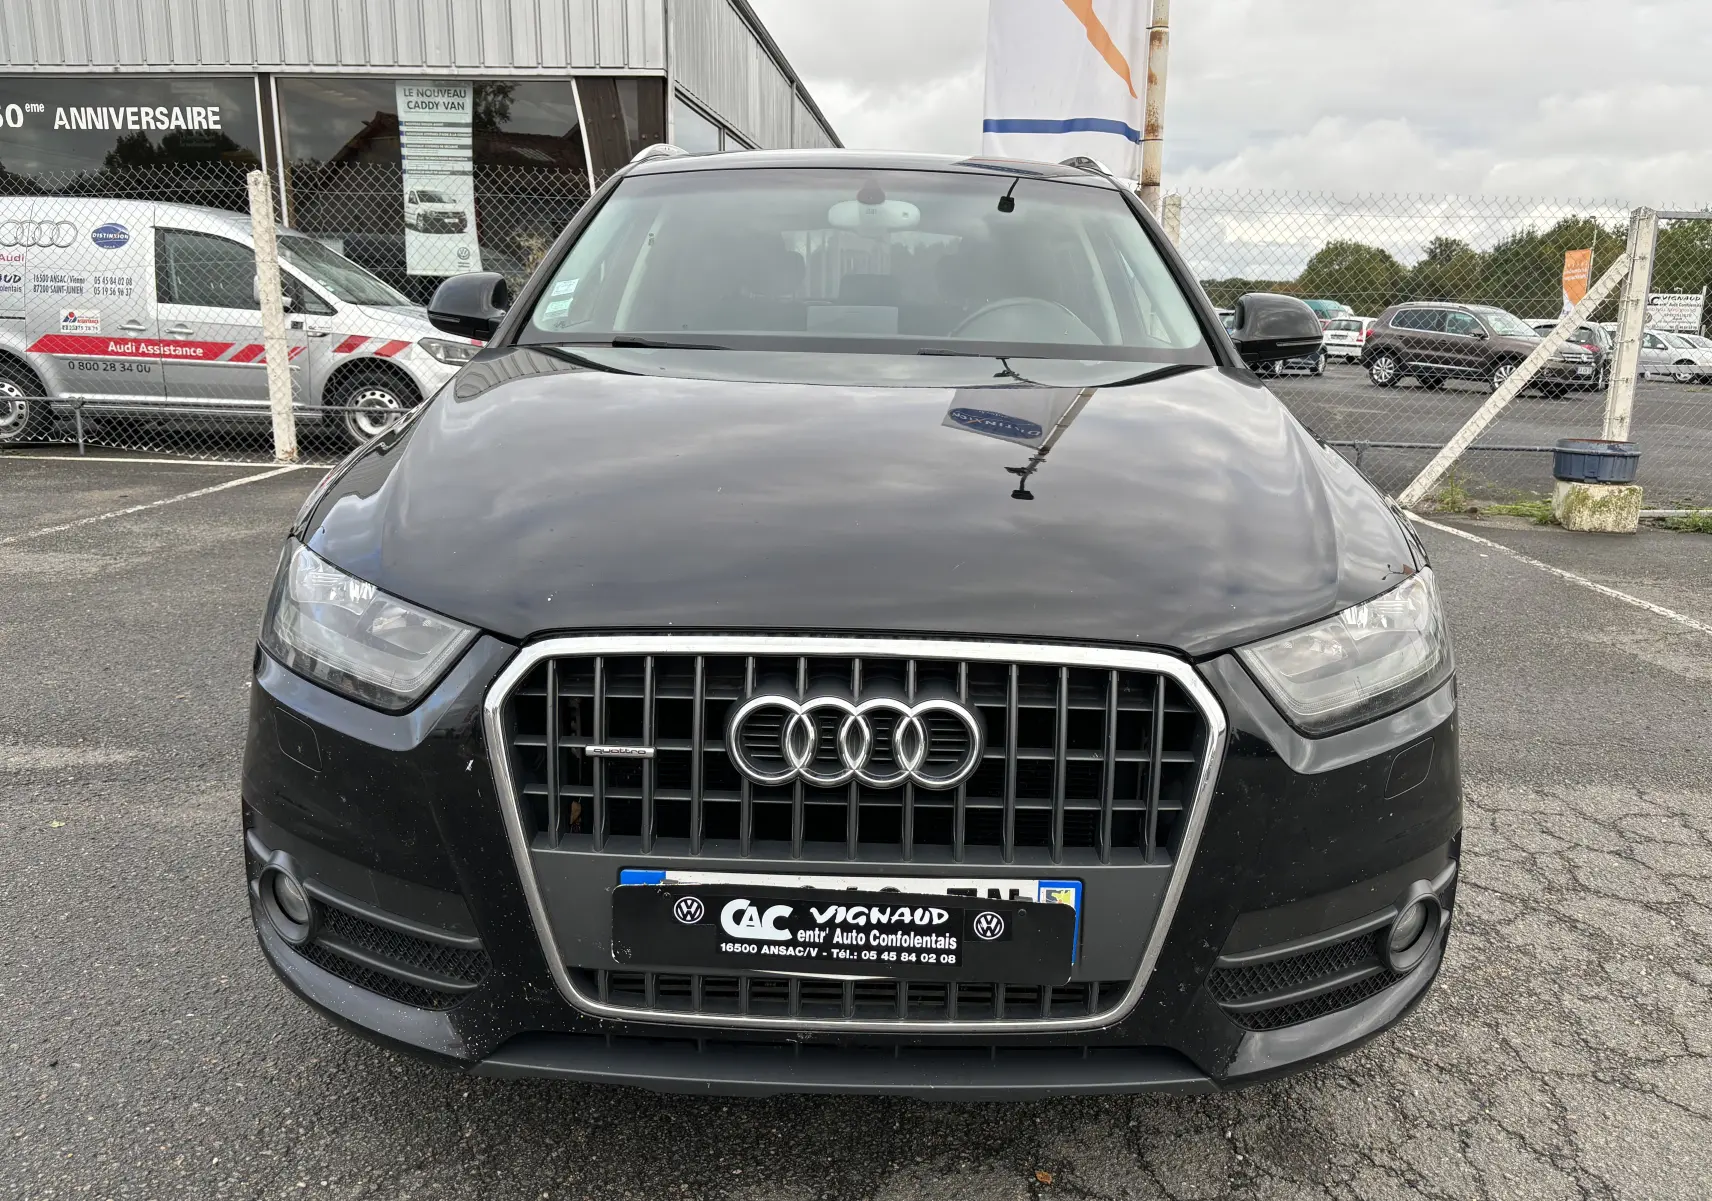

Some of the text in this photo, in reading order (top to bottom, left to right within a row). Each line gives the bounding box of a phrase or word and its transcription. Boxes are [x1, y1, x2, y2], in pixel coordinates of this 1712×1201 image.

[403, 88, 467, 98] LE NOUVEAU
[407, 101, 465, 110] CADDY VAN
[54, 107, 222, 130] ANNIVERSAIRE
[110, 276, 116, 285] 84
[102, 287, 108, 295] 19
[108, 341, 204, 356] Audi Assistance
[68, 361, 75, 370] 0
[78, 362, 99, 371] 800
[103, 363, 116, 372] 28
[120, 363, 133, 372] 34
[720, 898, 949, 940] CAC VIGNAUD
[797, 928, 957, 949] entr' Auto Confolentais
[720, 943, 757, 953] 16500
[761, 945, 818, 957] ANSAC/V
[831, 948, 857, 959] Tél.:
[862, 950, 877, 960] 05
[881, 952, 896, 960] 45
[901, 952, 916, 962] 84
[920, 954, 936, 962] 02
[940, 954, 956, 963] 08
